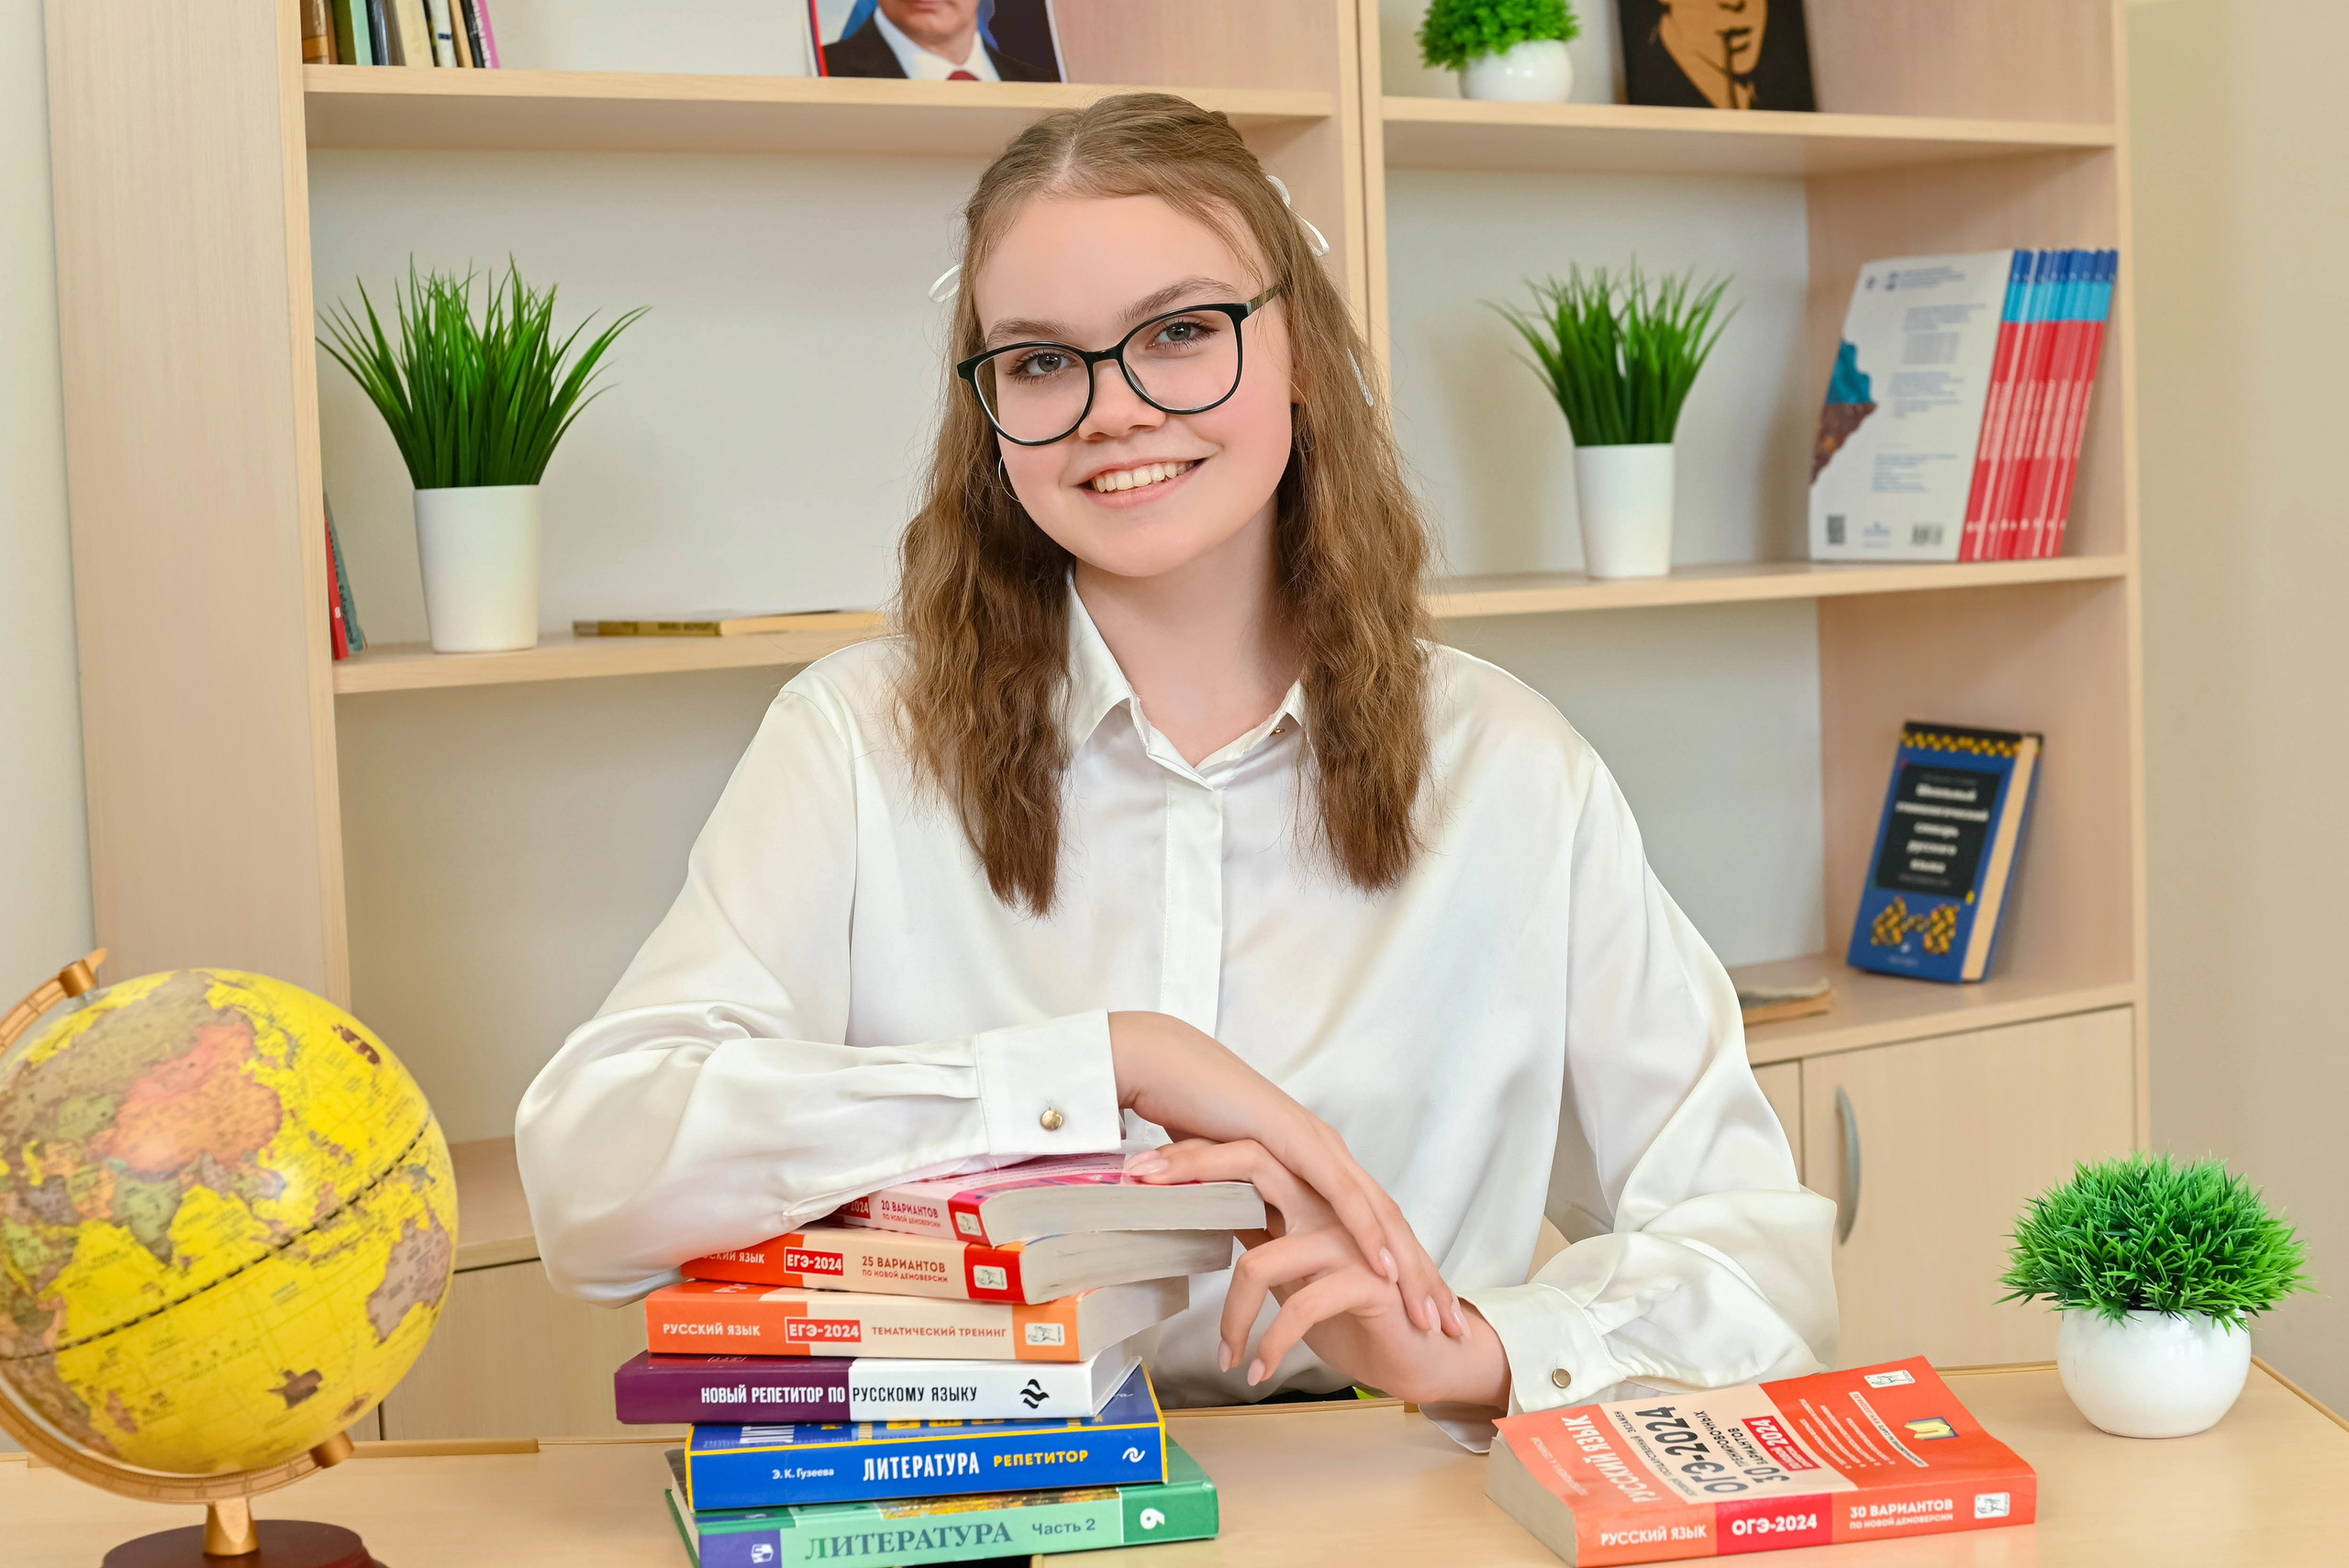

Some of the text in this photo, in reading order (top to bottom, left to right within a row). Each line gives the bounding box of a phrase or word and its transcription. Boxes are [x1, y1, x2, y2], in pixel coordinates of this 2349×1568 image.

[881, 1200, 939, 1218] 20 ВАРИАНТОВ
[891, 1214, 908, 1223] НОВОЙ
[739, 1252, 765, 1264] ЯЗЫК
[786, 1254, 842, 1271] ЕГЭ-2024
[862, 1256, 946, 1273] 25 ВАРИАНТОВ
[862, 1269, 948, 1283] ПО НОВОЙ ДЕМОВЕРСИИ
[662, 1322, 761, 1337] РУССКИЙ ЯЗЫК
[788, 1324, 860, 1338] ЕГЭ-2024
[872, 1326, 1006, 1338] ТЕМАТИЧЕСКИЙ ТРЕНИНГ
[701, 1384, 977, 1404] НОВЫЙ РЕПЕТИТОР ПО РУССКОМУ ЯЗЫКУ
[1613, 1411, 1637, 1433] ЭКЗАМЕН
[1693, 1410, 1747, 1467] ТРЕНИРОВОЧНЫХ
[1750, 1419, 1789, 1447] 2024
[1634, 1406, 1749, 1494] ОГЭ-2024
[1727, 1428, 1769, 1465] ВАРИАНТОВ
[863, 1450, 1088, 1482] ЛИТЕРАТУРА РЕПЕТИТОР
[1561, 1414, 1662, 1503] РУССКИЙ ЯЗЫК
[796, 1467, 835, 1480] Гузеева
[1742, 1466, 1791, 1484] 30
[1850, 1498, 1954, 1518] 30 ВАРИАНТОВ
[1731, 1514, 1818, 1536] ОГЭ-2024
[1850, 1514, 1954, 1529] ПО НОВОЙ ДЕМОВЕРСИИ
[805, 1518, 1096, 1561] ЛИТЕРАТУРА Часть 2
[1601, 1525, 1707, 1547] РУССКИЙ ЯЗЫК
